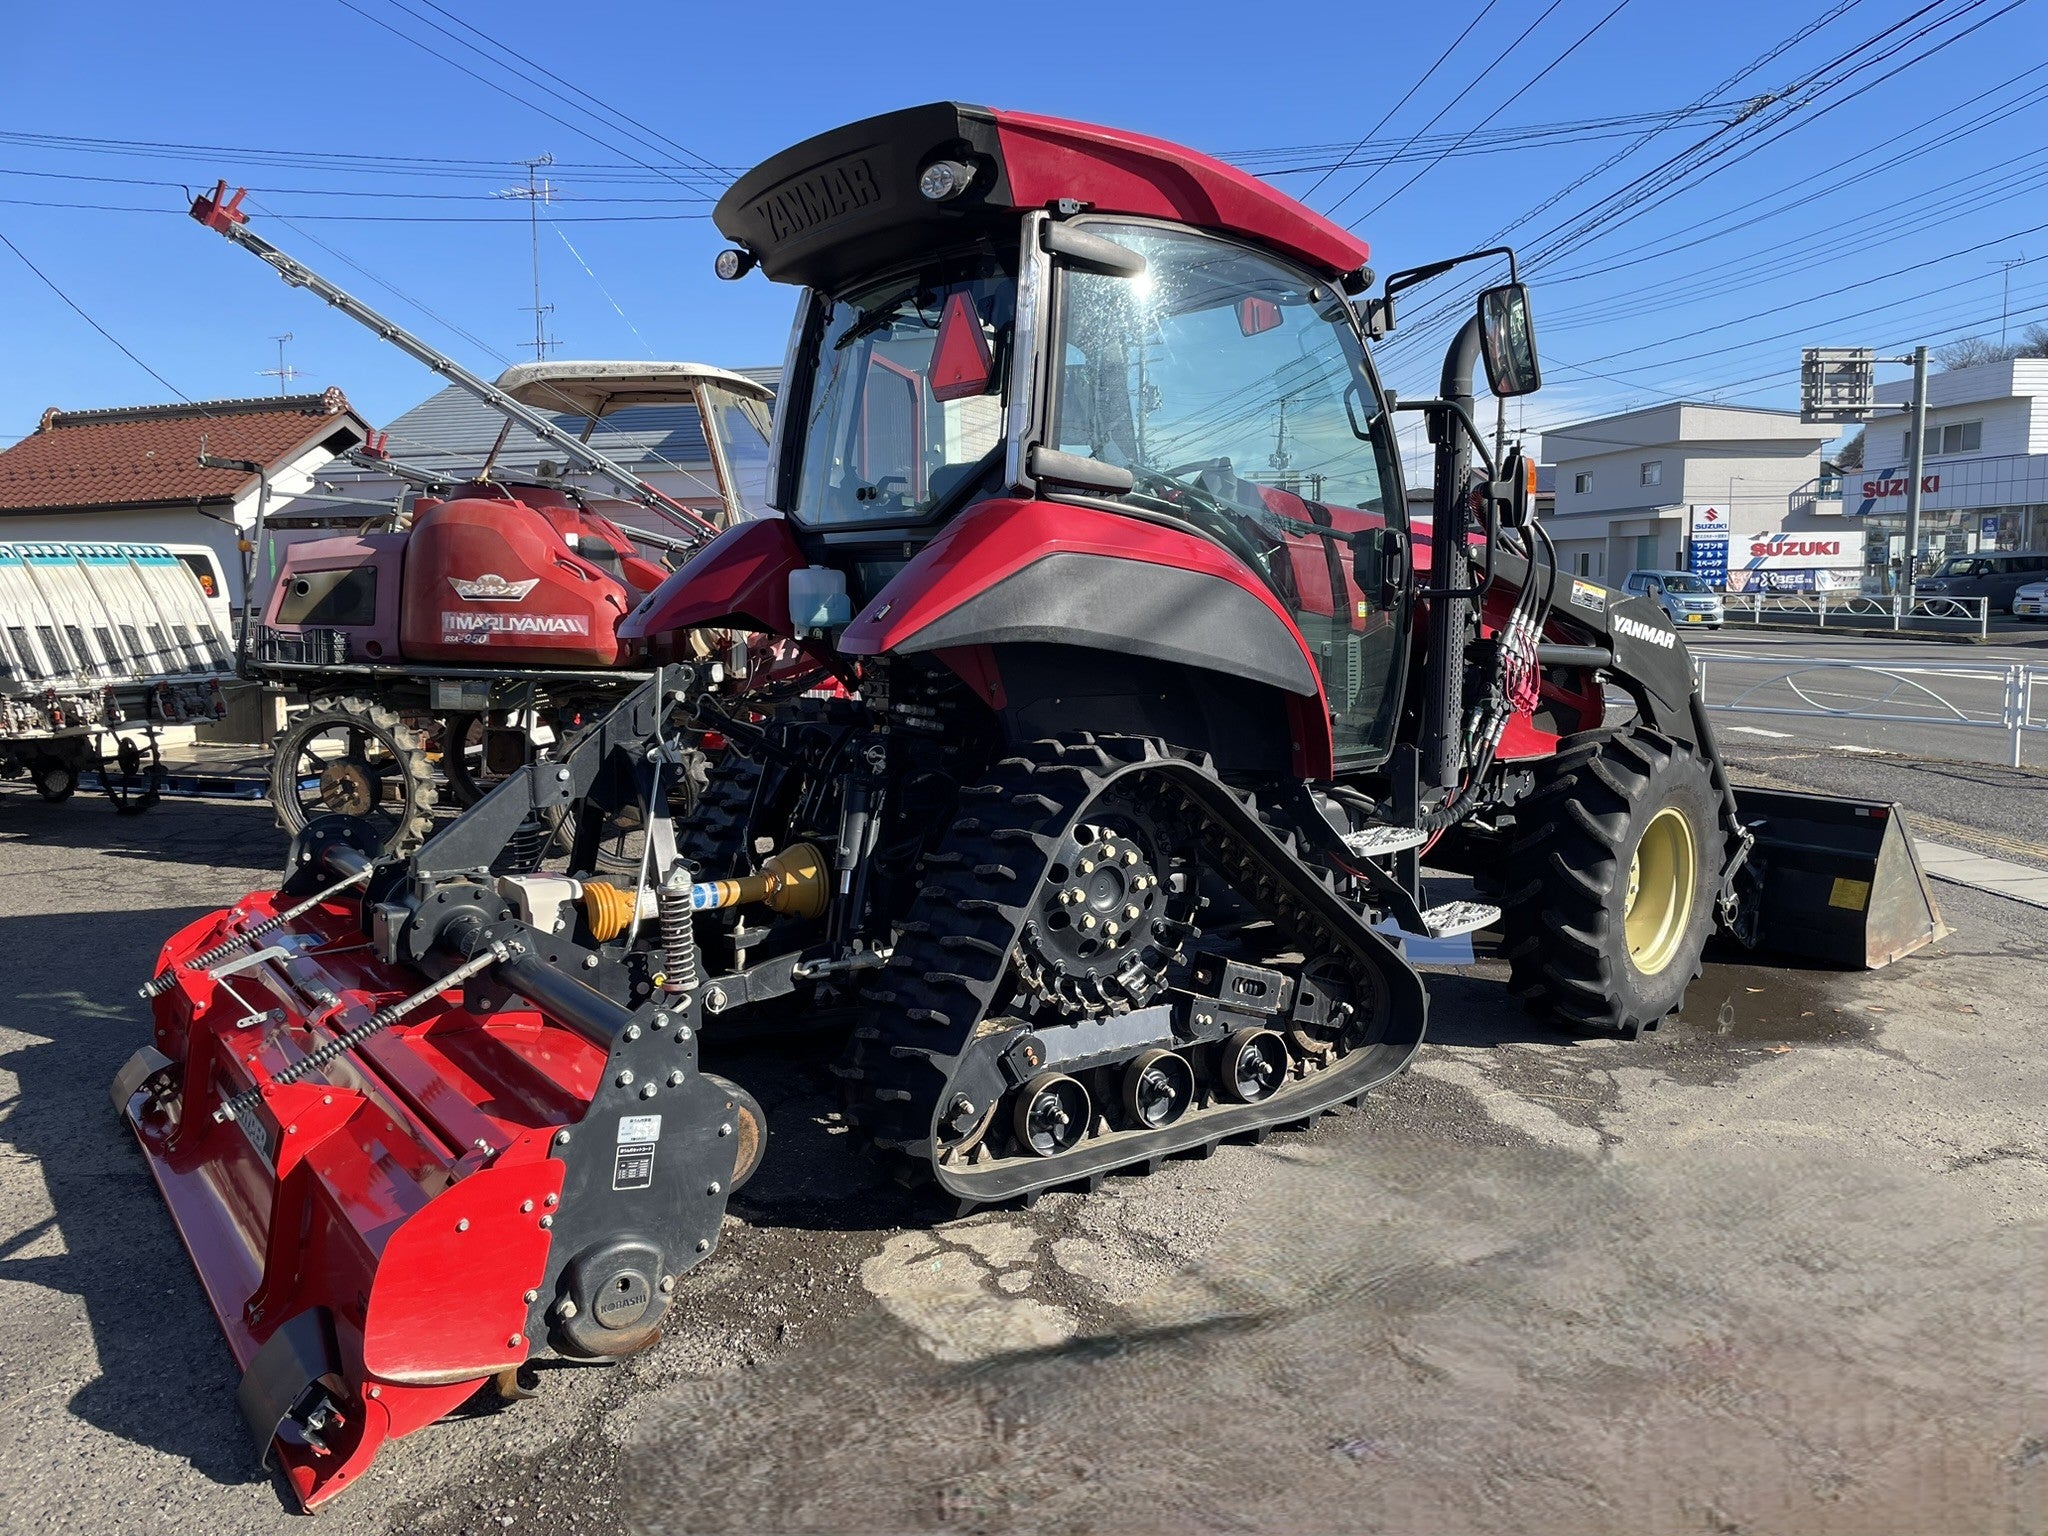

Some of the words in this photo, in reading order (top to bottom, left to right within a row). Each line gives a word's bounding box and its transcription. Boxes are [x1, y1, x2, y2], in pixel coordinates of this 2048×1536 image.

[756, 158, 881, 243] YANMAR
[1750, 541, 1840, 556] SUZUKI
[460, 586, 525, 595] ベジキング
[456, 616, 568, 633] MARUYAMA
[1613, 614, 1676, 650] YANMAR
[600, 1294, 647, 1314] KOBASHI
